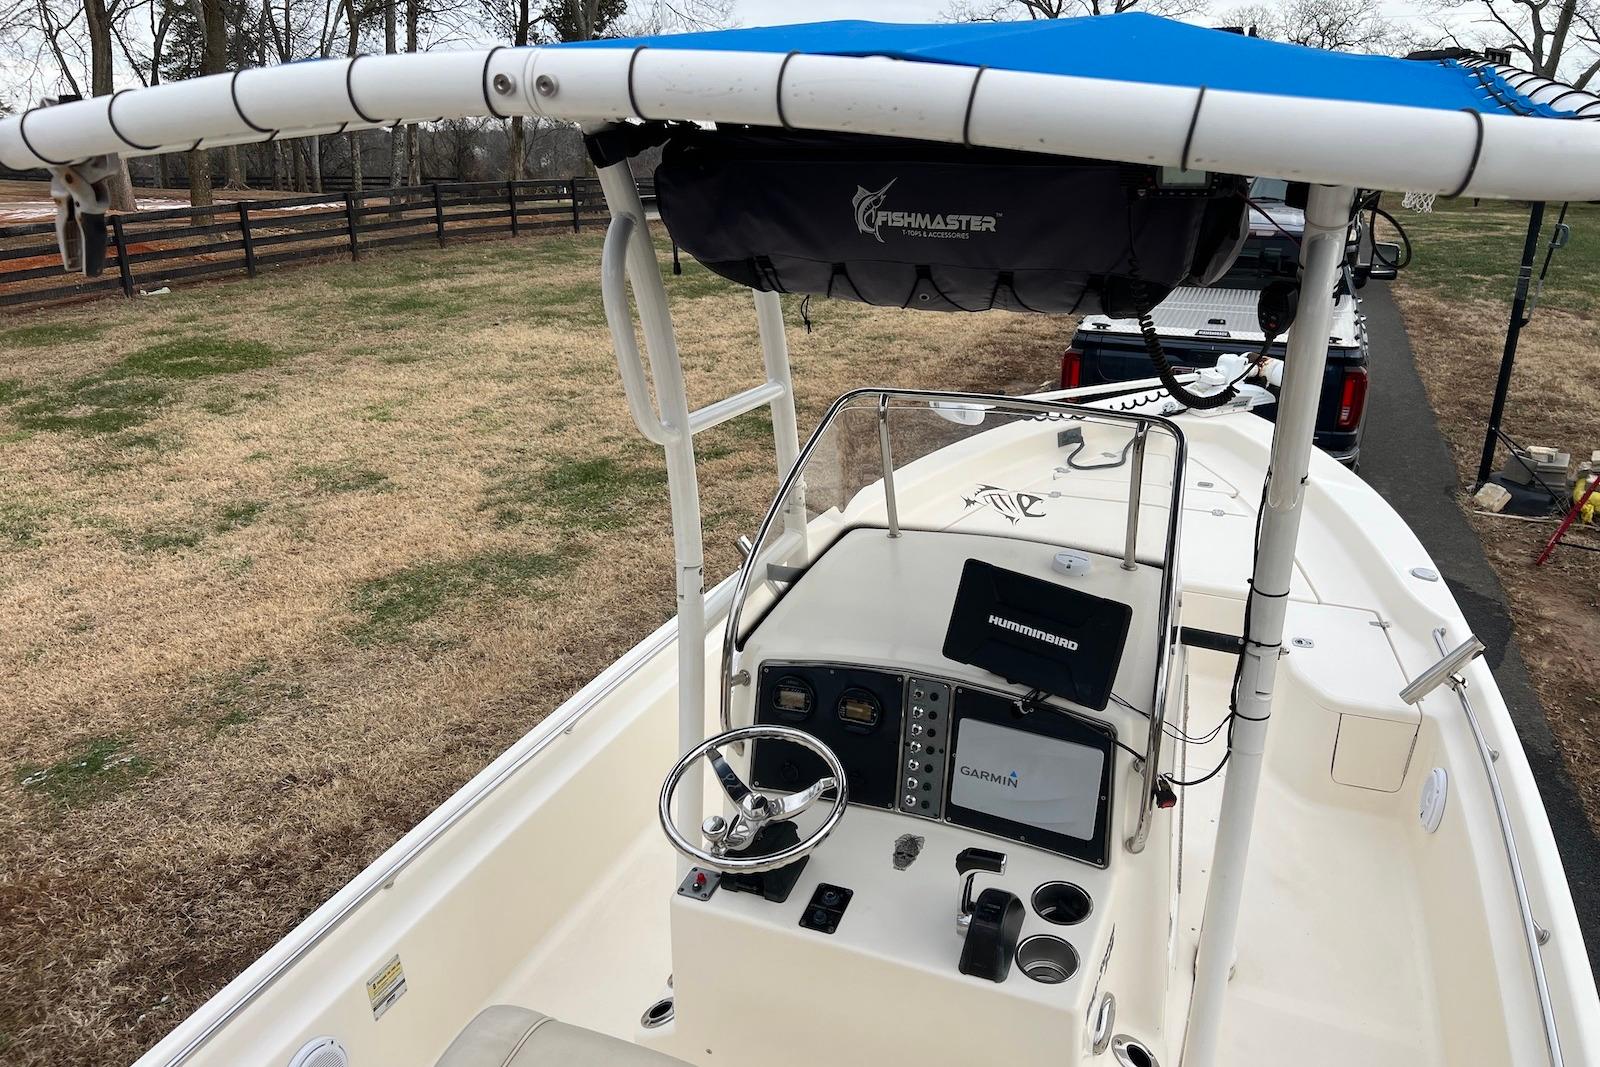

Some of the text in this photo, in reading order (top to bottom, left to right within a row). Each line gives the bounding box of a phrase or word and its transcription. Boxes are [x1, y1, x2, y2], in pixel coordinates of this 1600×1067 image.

[877, 210, 996, 232] FISHMASTER
[928, 231, 970, 239] ACCESSORIES
[988, 614, 1078, 651] HUMMINBIRD
[960, 766, 1018, 788] GARMIN
